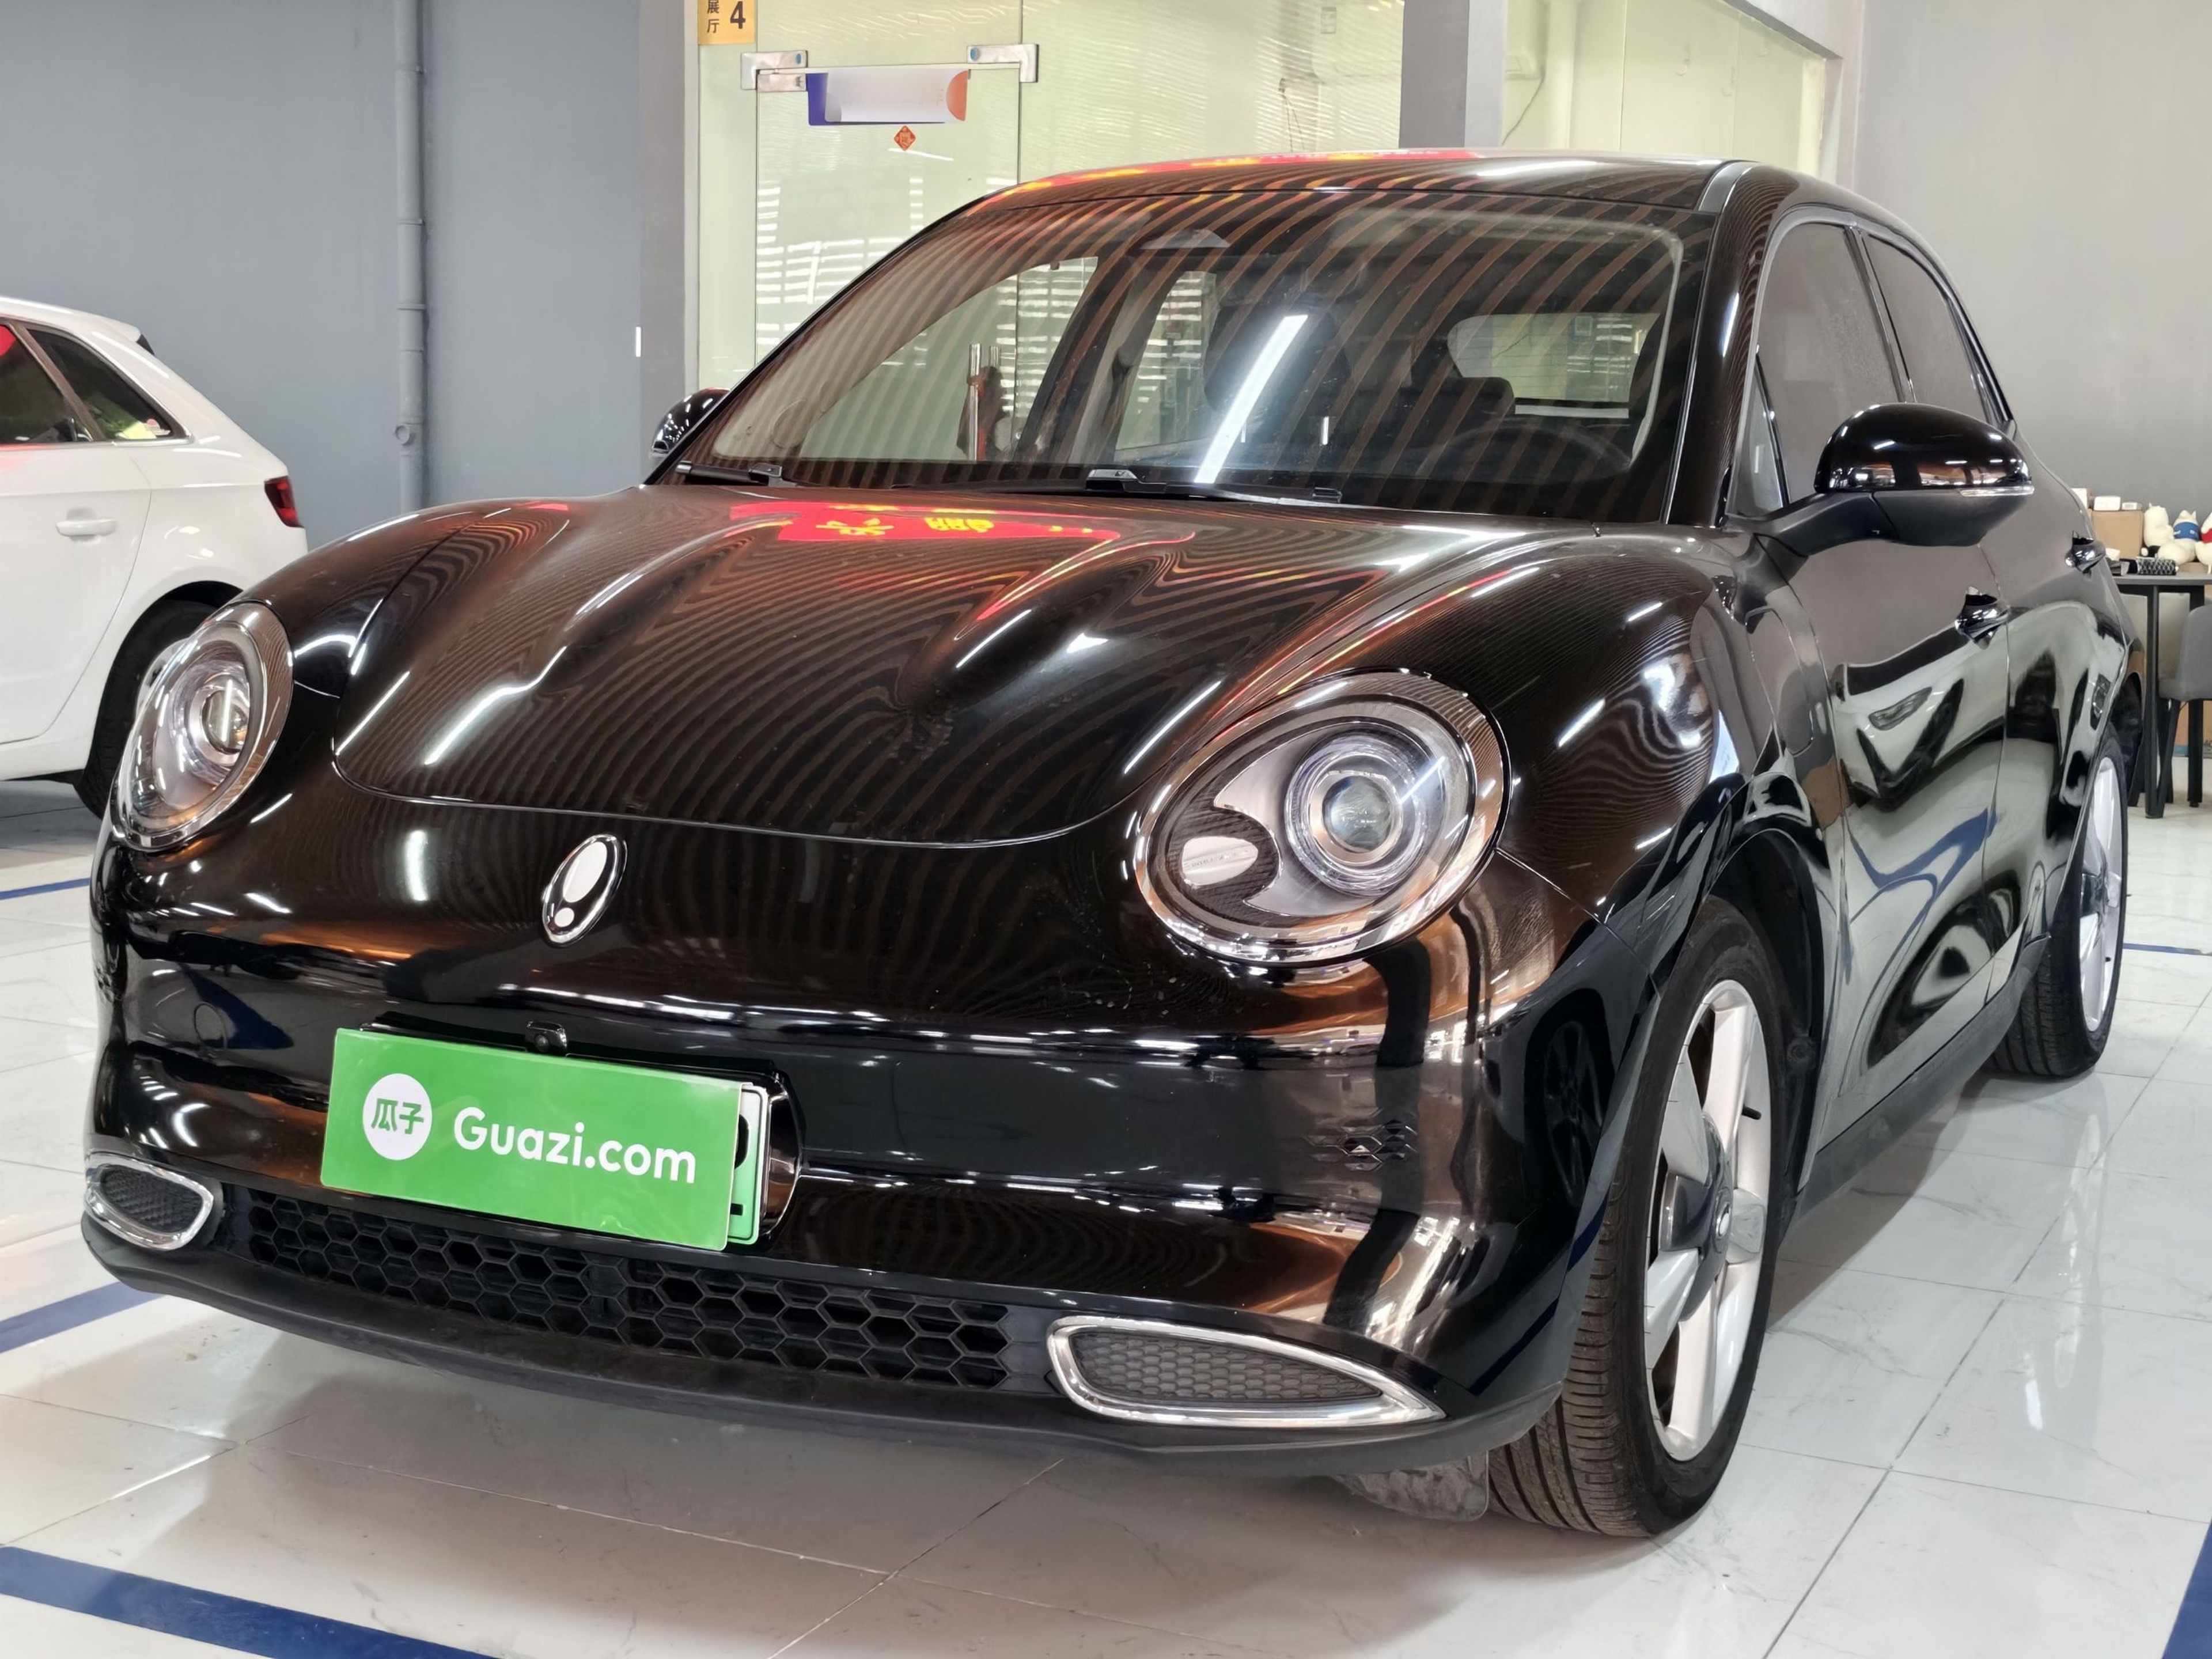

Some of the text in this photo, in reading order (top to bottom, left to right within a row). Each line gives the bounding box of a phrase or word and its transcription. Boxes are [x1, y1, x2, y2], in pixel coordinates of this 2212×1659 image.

[707, 0, 719, 33] 展厅
[730, 1, 746, 29] 4
[371, 1099, 424, 1135] 瓜子
[454, 1107, 696, 1183] Guazi.com
